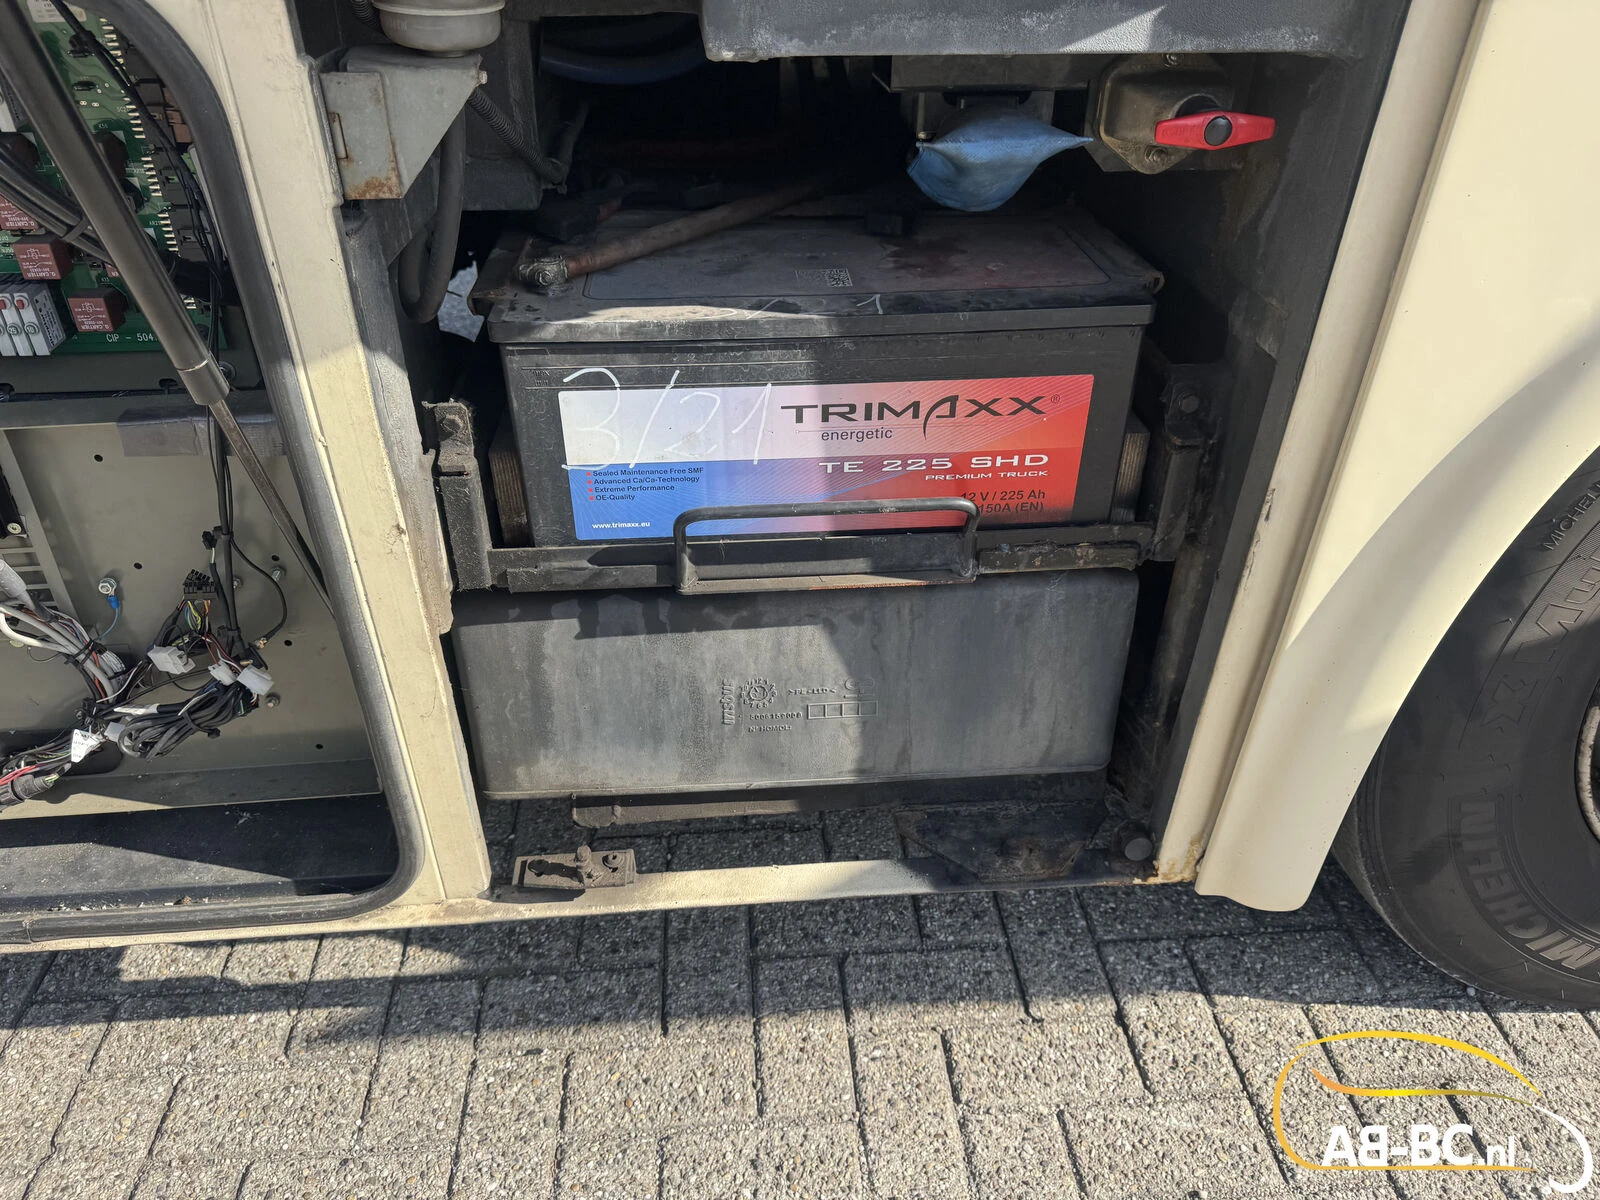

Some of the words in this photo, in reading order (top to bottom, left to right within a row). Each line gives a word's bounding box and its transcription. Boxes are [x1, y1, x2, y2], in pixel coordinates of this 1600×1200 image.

[106, 333, 120, 342] CIP
[136, 332, 158, 342] 504
[562, 367, 772, 470] 3/21
[781, 394, 1046, 440] TRIMAXX
[821, 427, 893, 443] energetic
[819, 461, 863, 474] TE
[882, 458, 953, 472] 225
[970, 453, 1049, 468] SHD
[592, 469, 618, 477] Sealed
[620, 468, 668, 476] Maintenance
[670, 467, 687, 475] Free
[925, 472, 992, 481] PREMIUM
[998, 470, 1049, 479] TRUCK
[627, 484, 675, 492] Performance
[595, 493, 636, 501] OE-Quality
[980, 491, 990, 501] V
[1000, 490, 1025, 500] 225
[1027, 489, 1046, 500] Ah
[1015, 501, 1044, 513] (EN)
[592, 521, 651, 529] www.trimaxx.eu
[1459, 799, 1600, 972] MICHELIN
